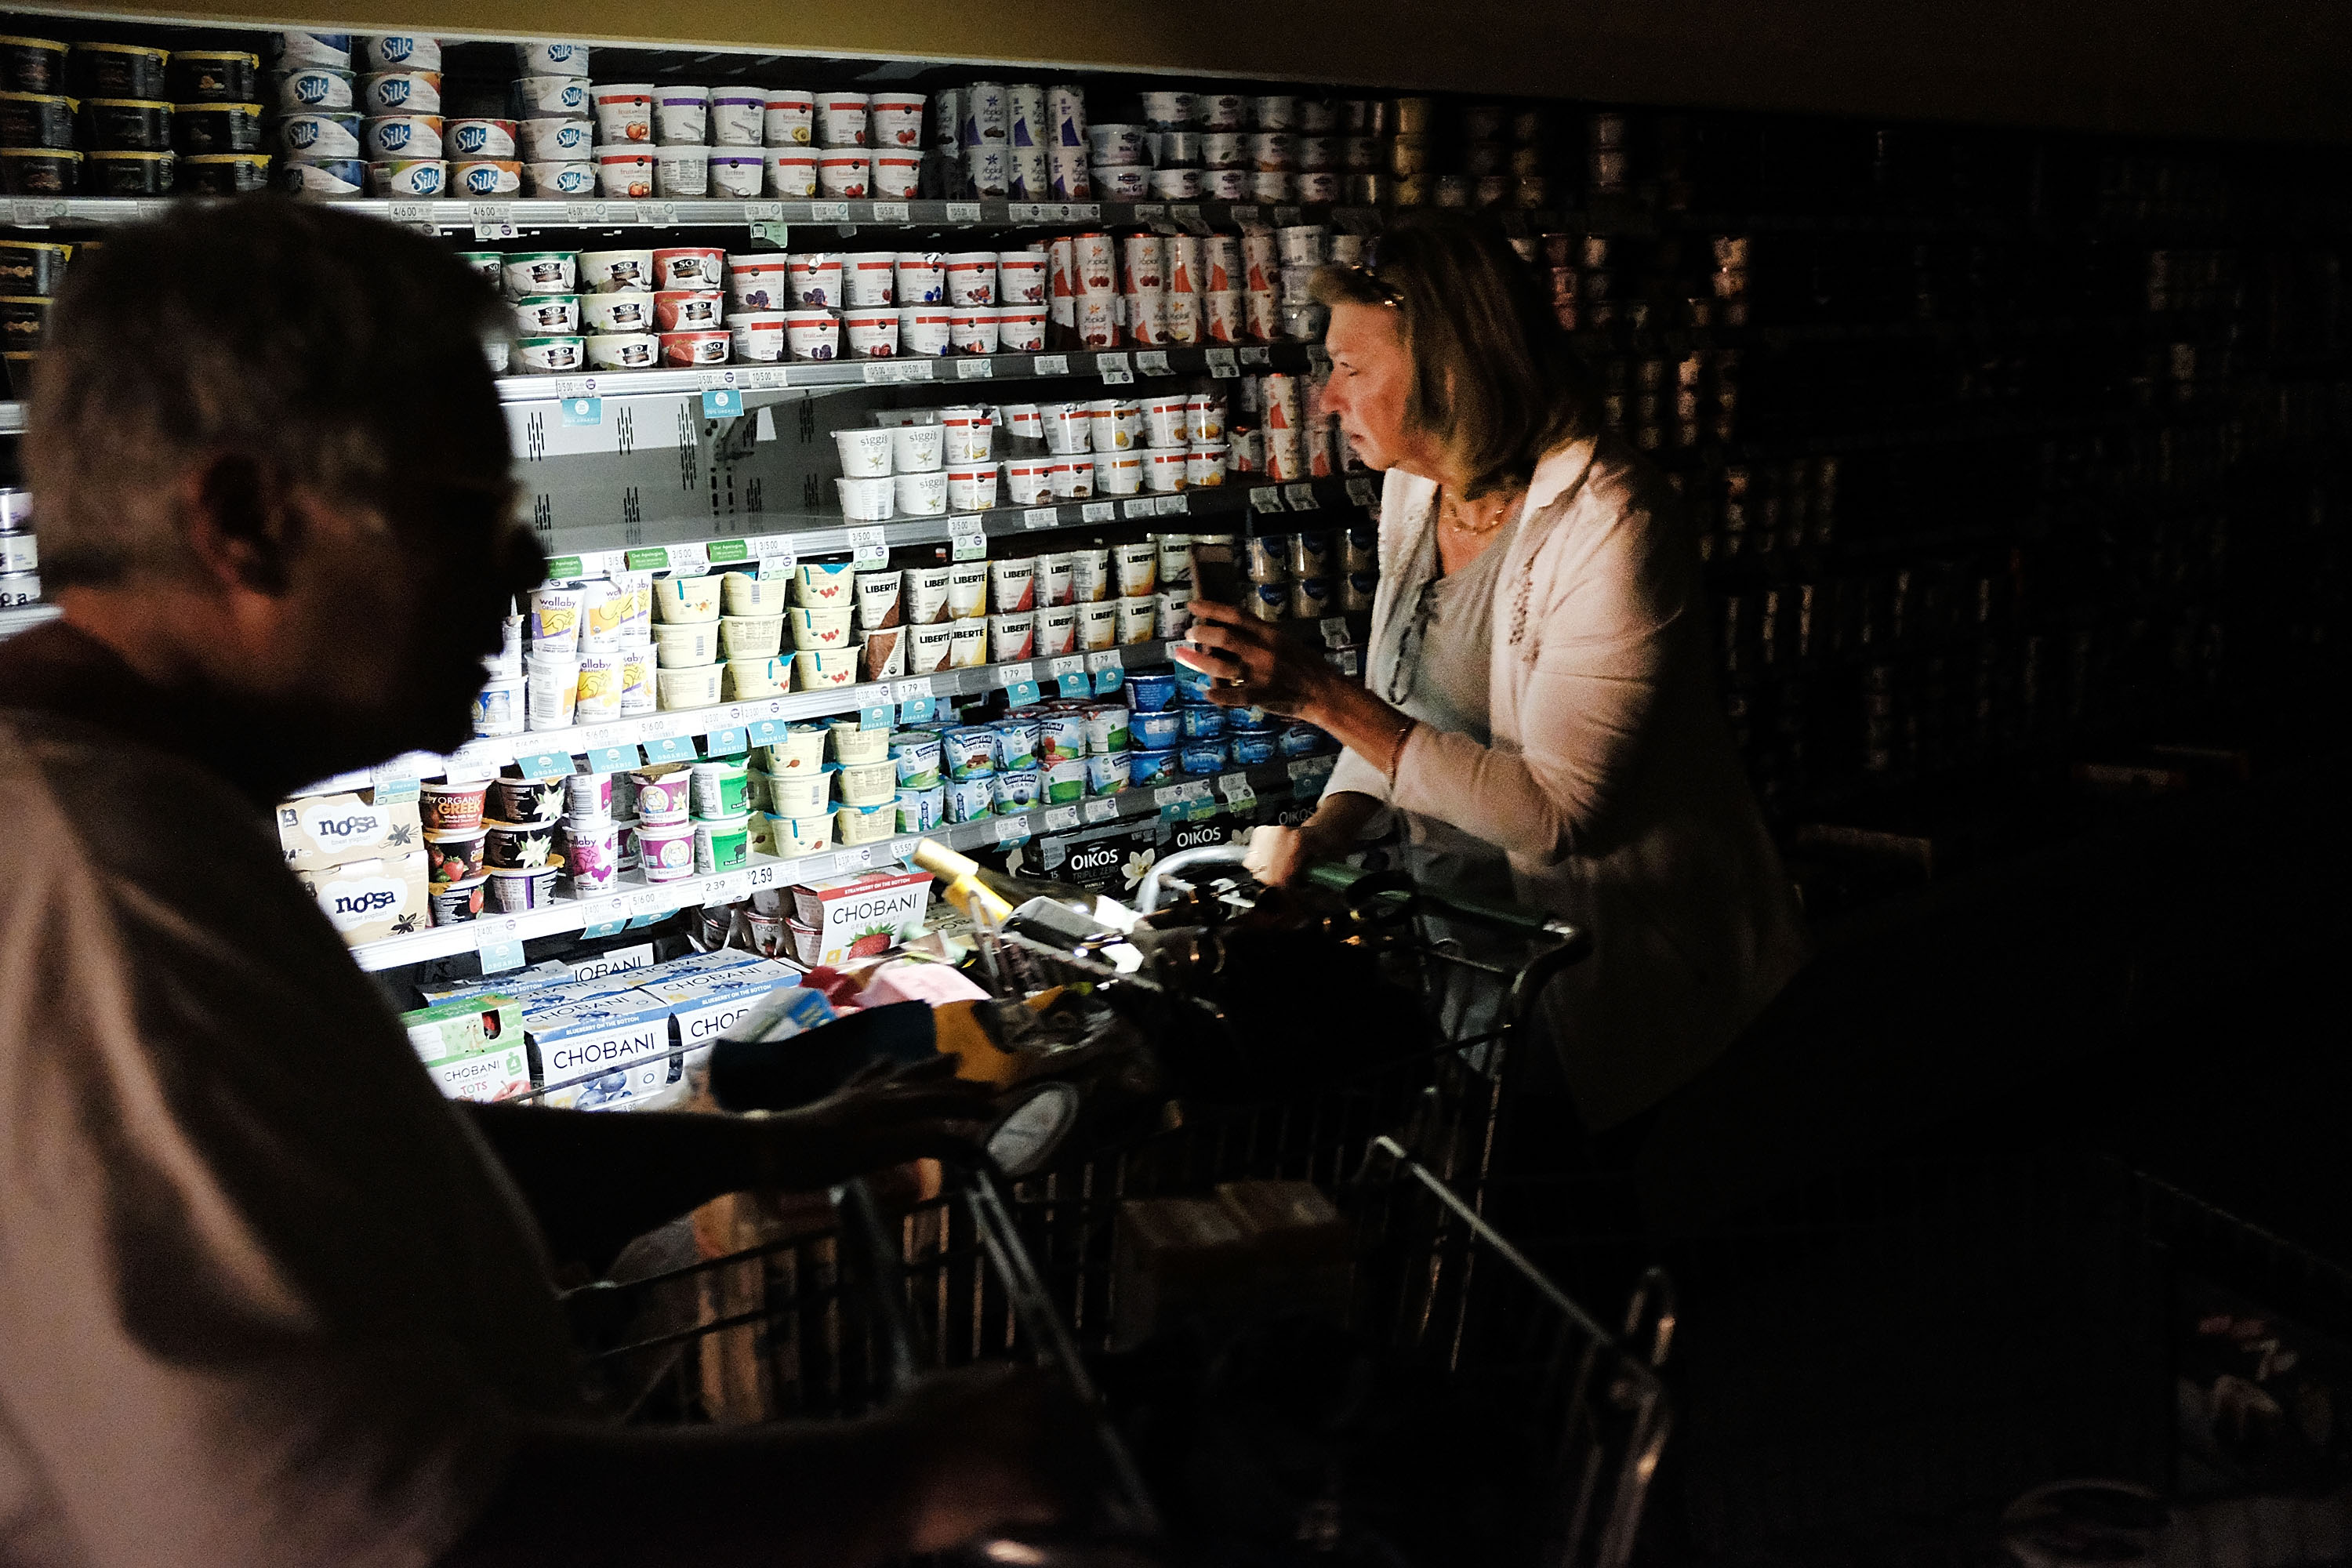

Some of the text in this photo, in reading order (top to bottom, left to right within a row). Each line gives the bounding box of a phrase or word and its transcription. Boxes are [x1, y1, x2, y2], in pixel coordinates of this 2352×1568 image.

[382, 38, 412, 62] Silk
[549, 45, 572, 61] Silk
[296, 78, 328, 103] Silk
[379, 81, 409, 105] Silk
[561, 87, 583, 106] Silk
[289, 122, 318, 147] Silk
[380, 123, 410, 149] Silk
[456, 128, 485, 152] Silk
[557, 129, 580, 147] Silk
[412, 168, 440, 194] Silk
[468, 169, 498, 194] Silk
[557, 172, 582, 191] Silk
[539, 263, 555, 272] SO
[628, 344, 643, 353] SO
[953, 572, 985, 585] LIBERTÉ
[865, 580, 898, 594] LIBERTÉ
[539, 597, 576, 609] wallaby
[920, 630, 951, 644] LIBERTÉ
[581, 659, 612, 671] allaby
[904, 712, 933, 722] ORGANIC
[863, 720, 891, 730] ORGANIC
[756, 735, 786, 745] ORGANIC
[964, 735, 993, 748] Stonyfield
[657, 750, 689, 760] ORGANIC
[713, 744, 745, 754] ORGANIC
[532, 766, 567, 776] ORGANIC
[601, 761, 633, 771] ORGANIC
[1005, 774, 1036, 784] Stonyfield
[437, 794, 483, 804] ORGANIC
[437, 802, 481, 815] GREEK
[318, 816, 379, 837] noosa
[1177, 826, 1221, 848] OIKOS
[1071, 848, 1119, 870] OIKOS
[752, 867, 772, 886] 2.59
[1098, 866, 1119, 876] ZERO
[706, 880, 725, 891] 2.39
[844, 883, 874, 895] STRAWBERRY
[891, 877, 911, 886] BOTTOM
[336, 891, 396, 914] noosa
[833, 894, 917, 924] CHOBANI
[756, 924, 779, 933] CHOB
[487, 958, 523, 970] ORGANIC
[517, 983, 543, 993] BOTTOM
[702, 993, 731, 1005] BLUEBERRY
[750, 985, 772, 994] BOTTOM
[526, 996, 630, 1024] CHOBANI
[566, 1023, 596, 1036] BLUEBERRY
[616, 1016, 640, 1026] BOTTOM
[554, 1033, 655, 1069] CHOBANI
[444, 1060, 500, 1082] CHOBANI
[460, 1081, 488, 1095] TOTS
